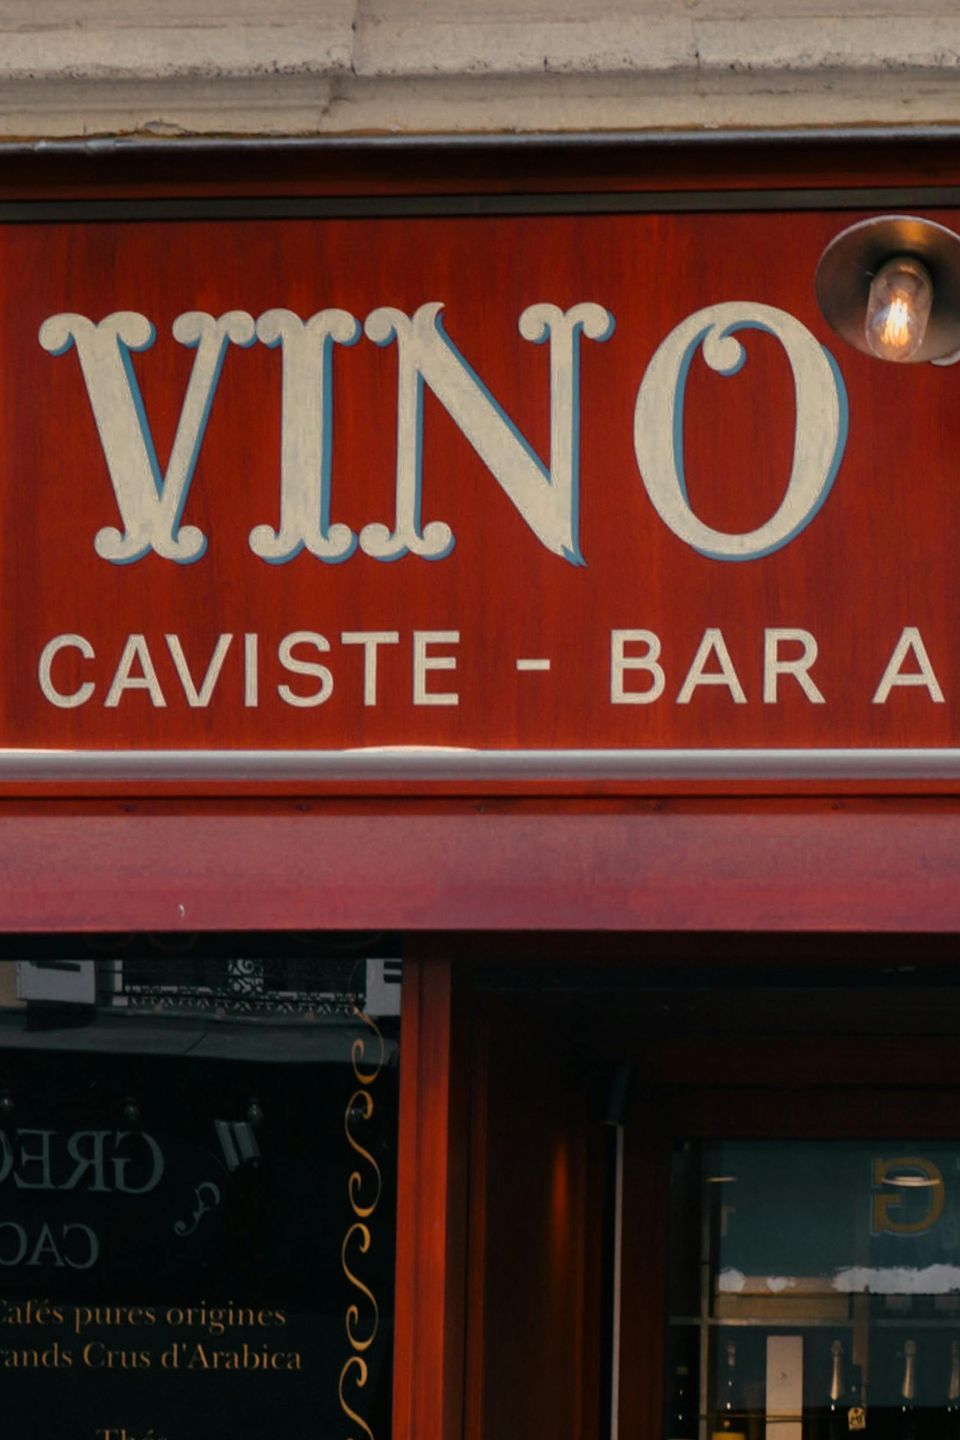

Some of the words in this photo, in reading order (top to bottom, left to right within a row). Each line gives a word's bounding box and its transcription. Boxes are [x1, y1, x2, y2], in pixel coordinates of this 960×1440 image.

[38, 300, 848, 567] VINO
[38, 632, 460, 708] CAVISTE
[517, 660, 550, 670] -
[611, 628, 826, 706] BAR
[873, 626, 945, 705] A
[75, 1304, 156, 1334] pures
[166, 1301, 286, 1336] origines
[83, 1342, 151, 1370] Crus
[161, 1343, 302, 1371] d'Arabica
